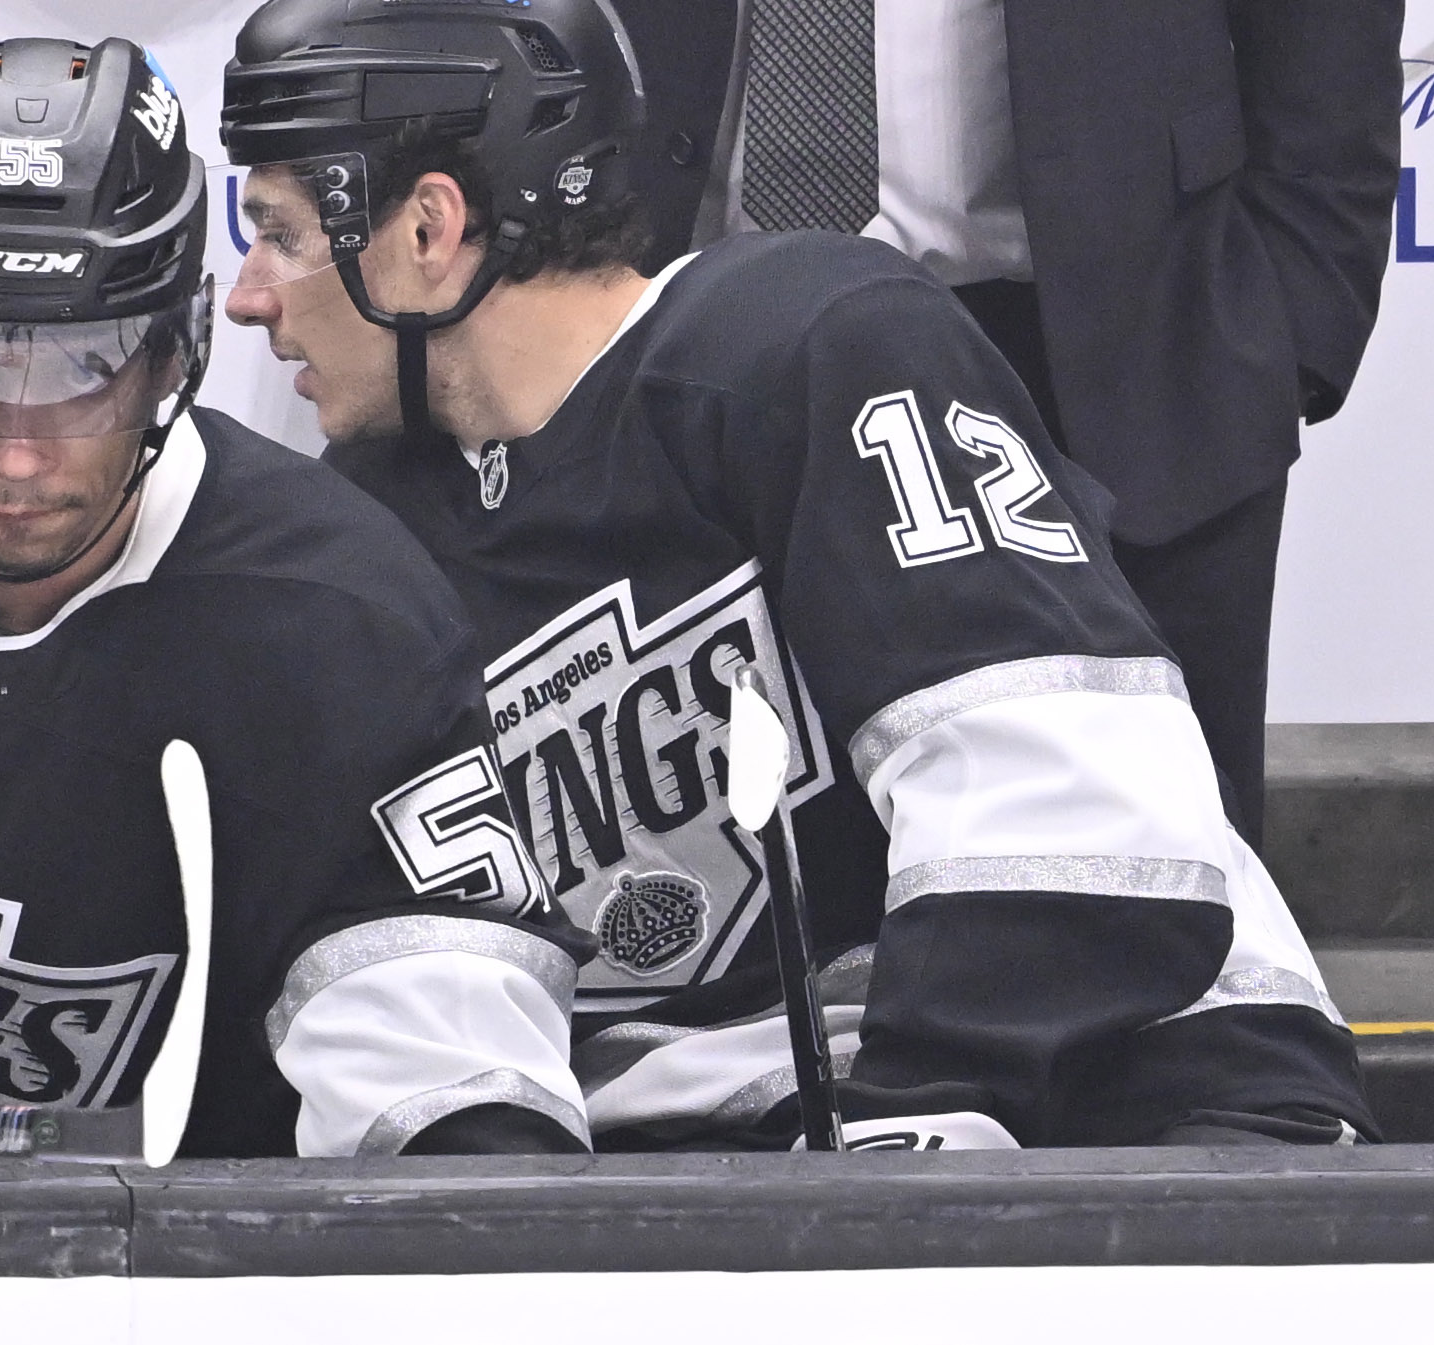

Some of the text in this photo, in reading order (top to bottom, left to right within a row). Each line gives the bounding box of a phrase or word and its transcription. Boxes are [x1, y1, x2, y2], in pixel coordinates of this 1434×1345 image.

[852, 390, 1090, 567] 12
[495, 641, 614, 735] os Angeles
